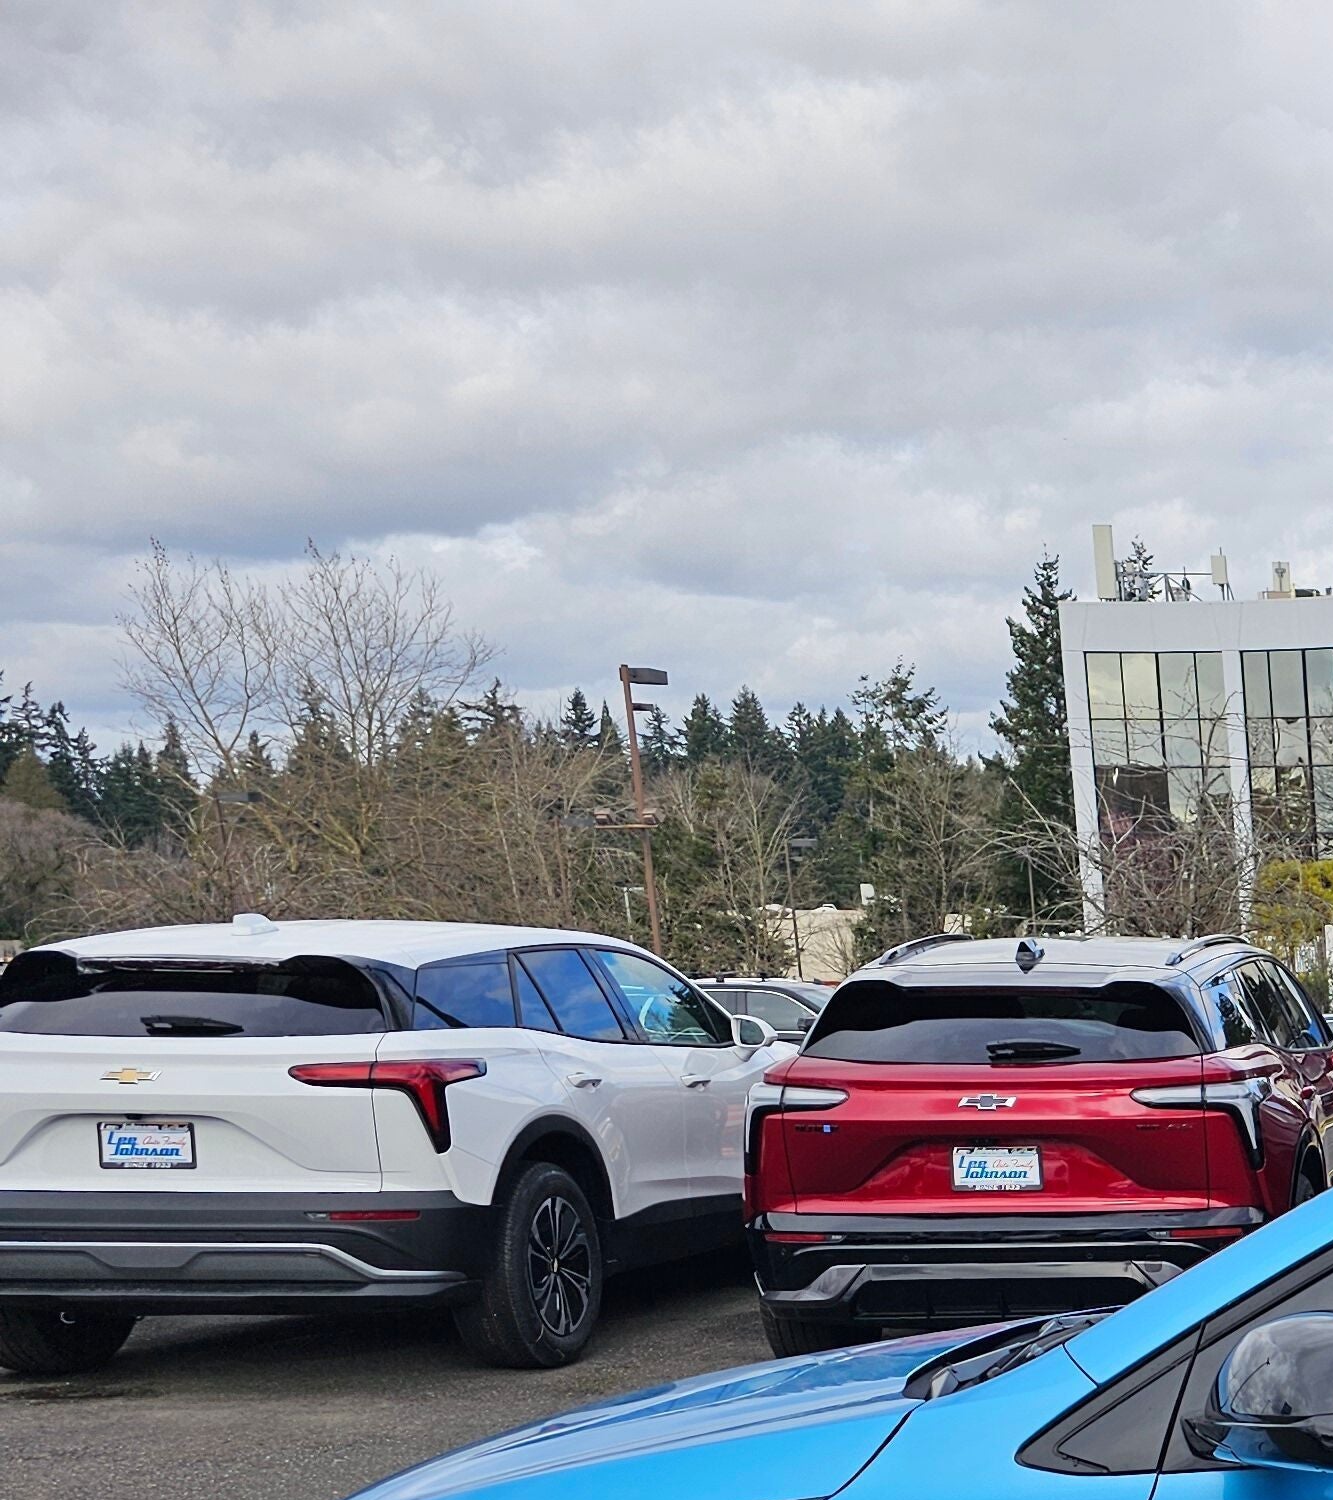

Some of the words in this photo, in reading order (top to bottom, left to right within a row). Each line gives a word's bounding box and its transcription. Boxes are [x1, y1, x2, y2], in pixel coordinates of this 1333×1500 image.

[107, 1131, 138, 1145] Lee
[109, 1142, 182, 1156] Johnson
[958, 1155, 988, 1168] Lee
[960, 1167, 1029, 1178] Johnson
